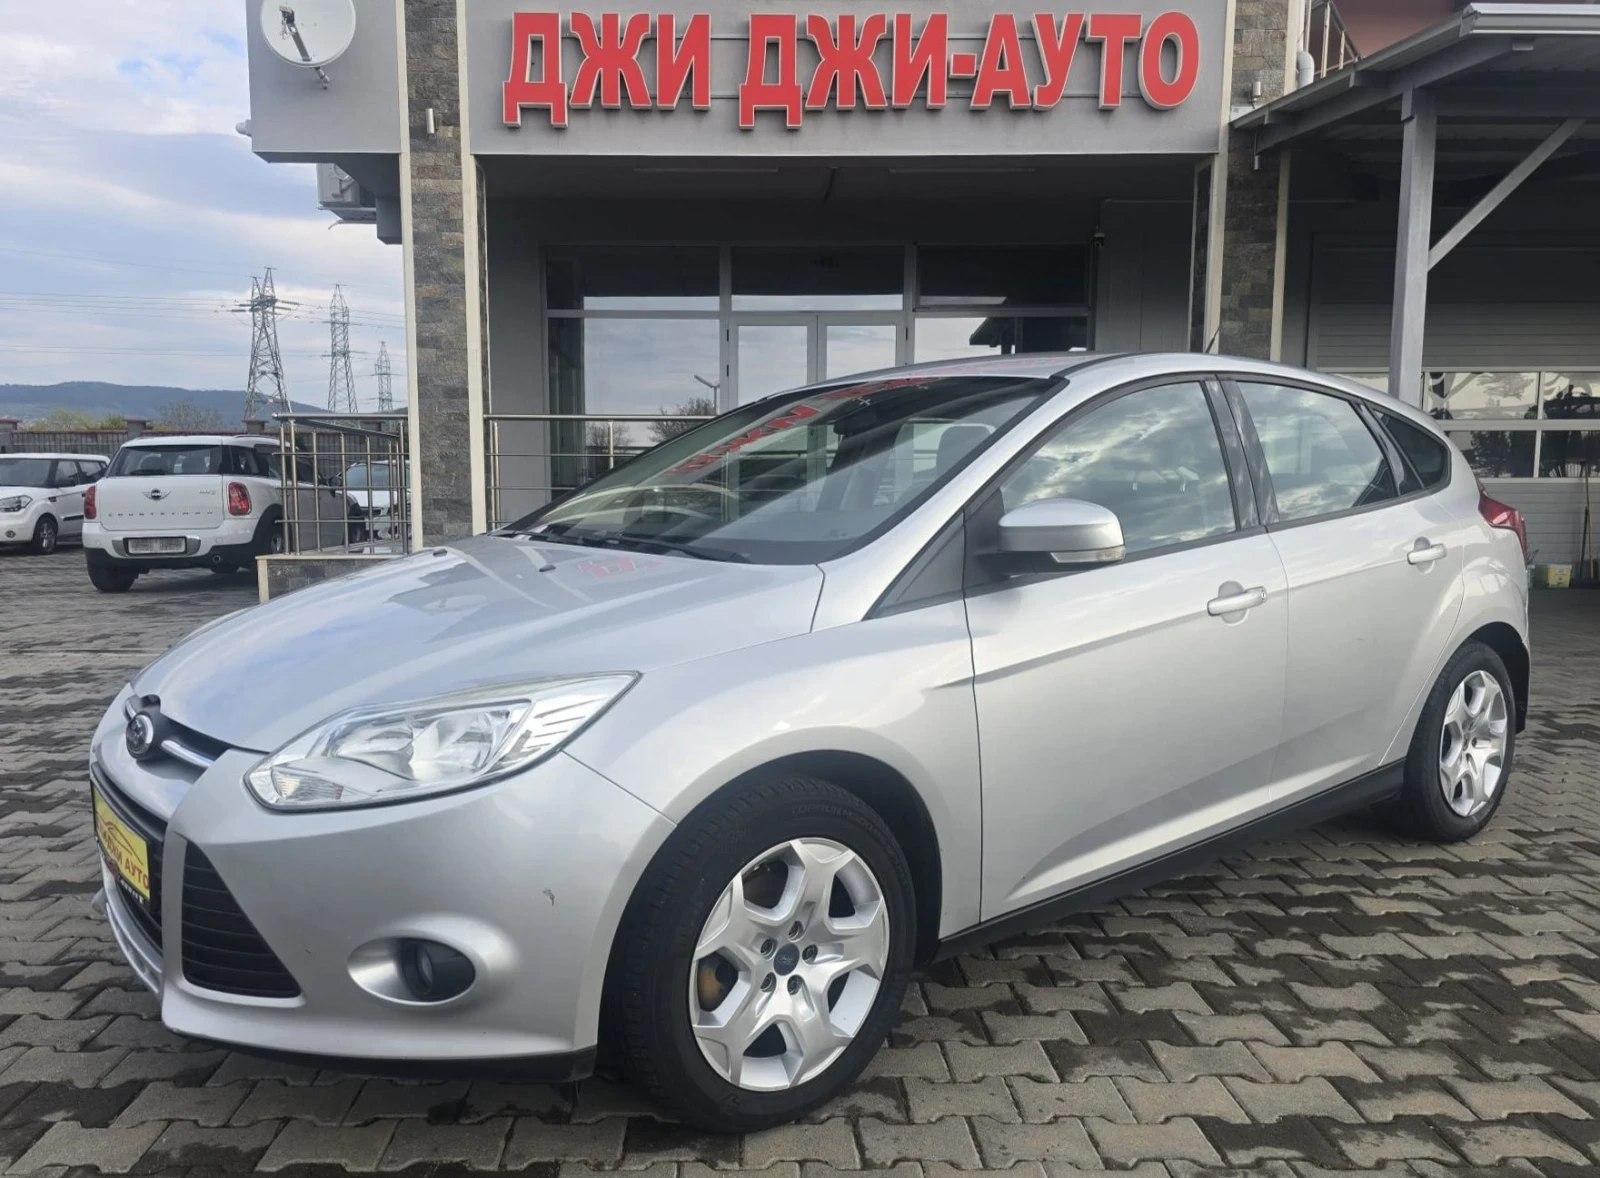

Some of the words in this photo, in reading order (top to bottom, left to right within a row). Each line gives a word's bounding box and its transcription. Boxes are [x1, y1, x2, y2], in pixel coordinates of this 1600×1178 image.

[502, 12, 713, 128] ДЖИ
[738, 11, 1200, 130] ДЖИ-АУТО
[124, 857, 149, 889] АУТО
